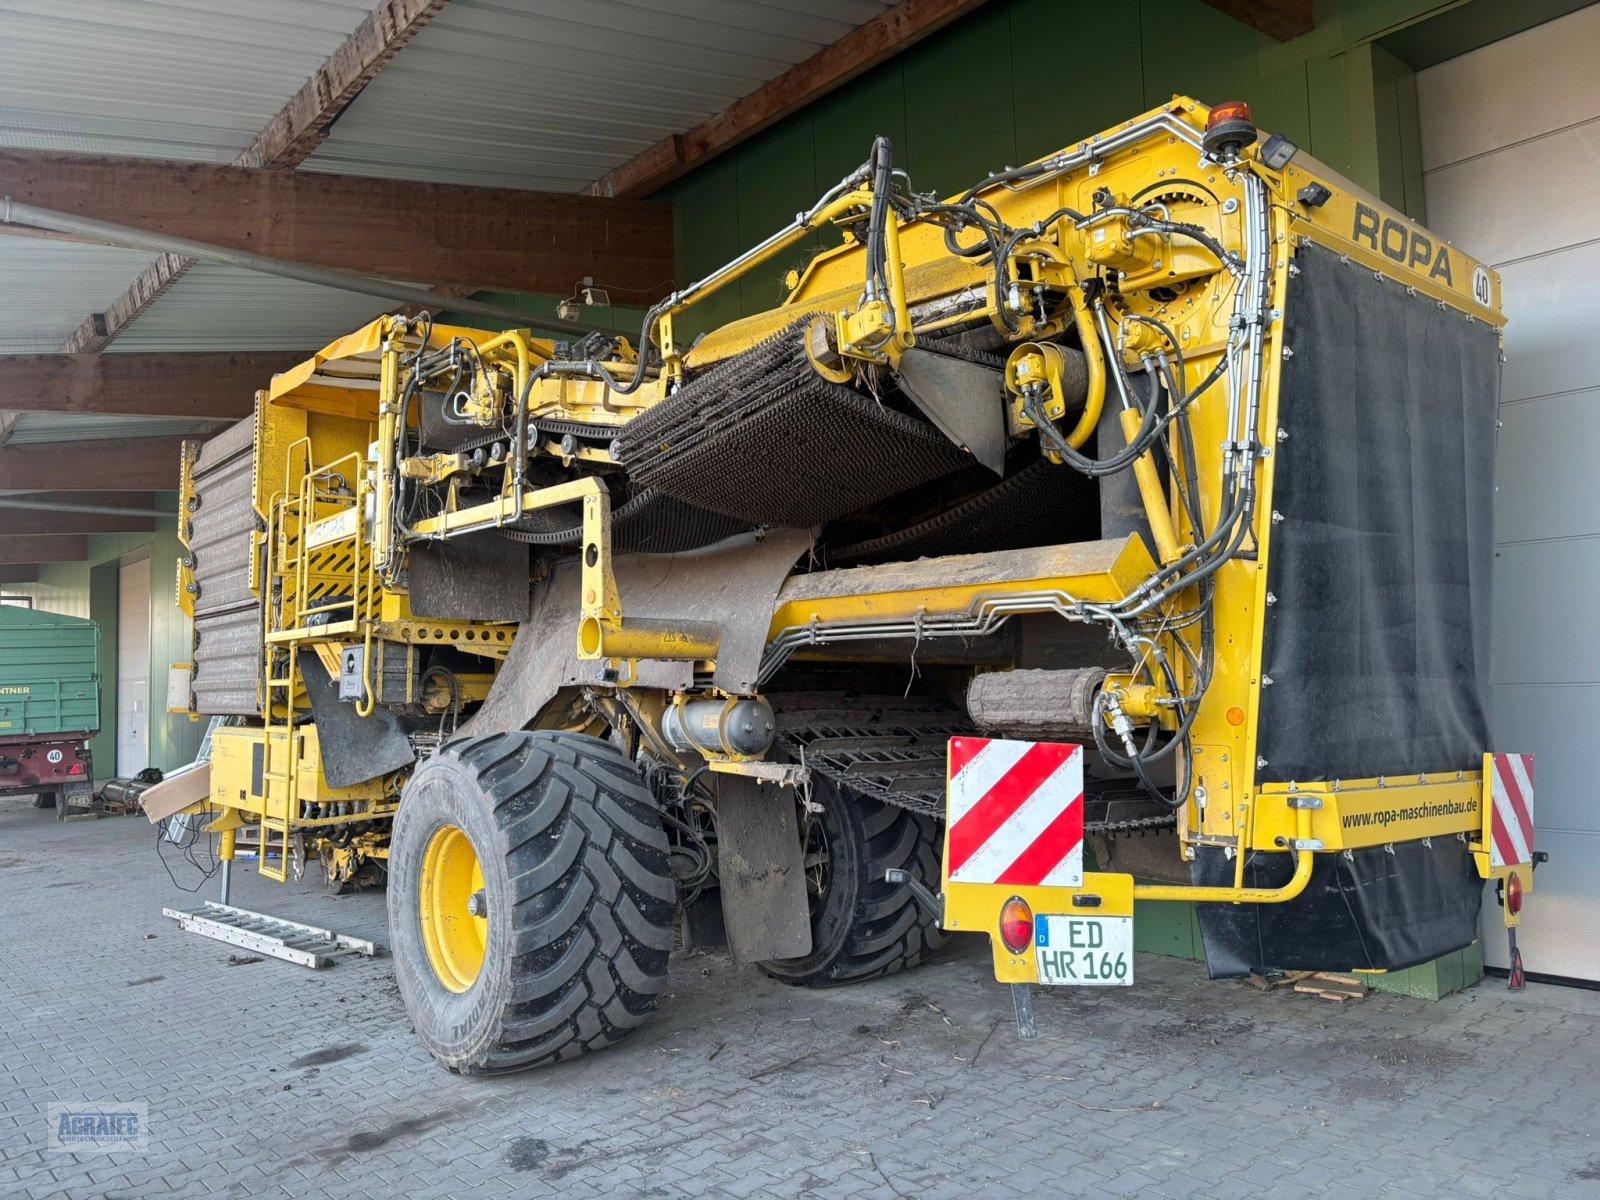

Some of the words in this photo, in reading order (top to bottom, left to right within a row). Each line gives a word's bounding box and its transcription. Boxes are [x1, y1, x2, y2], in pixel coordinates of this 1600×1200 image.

[1352, 202, 1453, 288] ROPA
[1475, 272, 1489, 305] 40
[49, 751, 60, 761] 40
[1342, 796, 1477, 828] www.ropa-maschinenbau.de
[1039, 935, 1045, 943] D
[1069, 920, 1103, 948] ED
[1041, 951, 1077, 979] HR
[1082, 952, 1128, 980] 166
